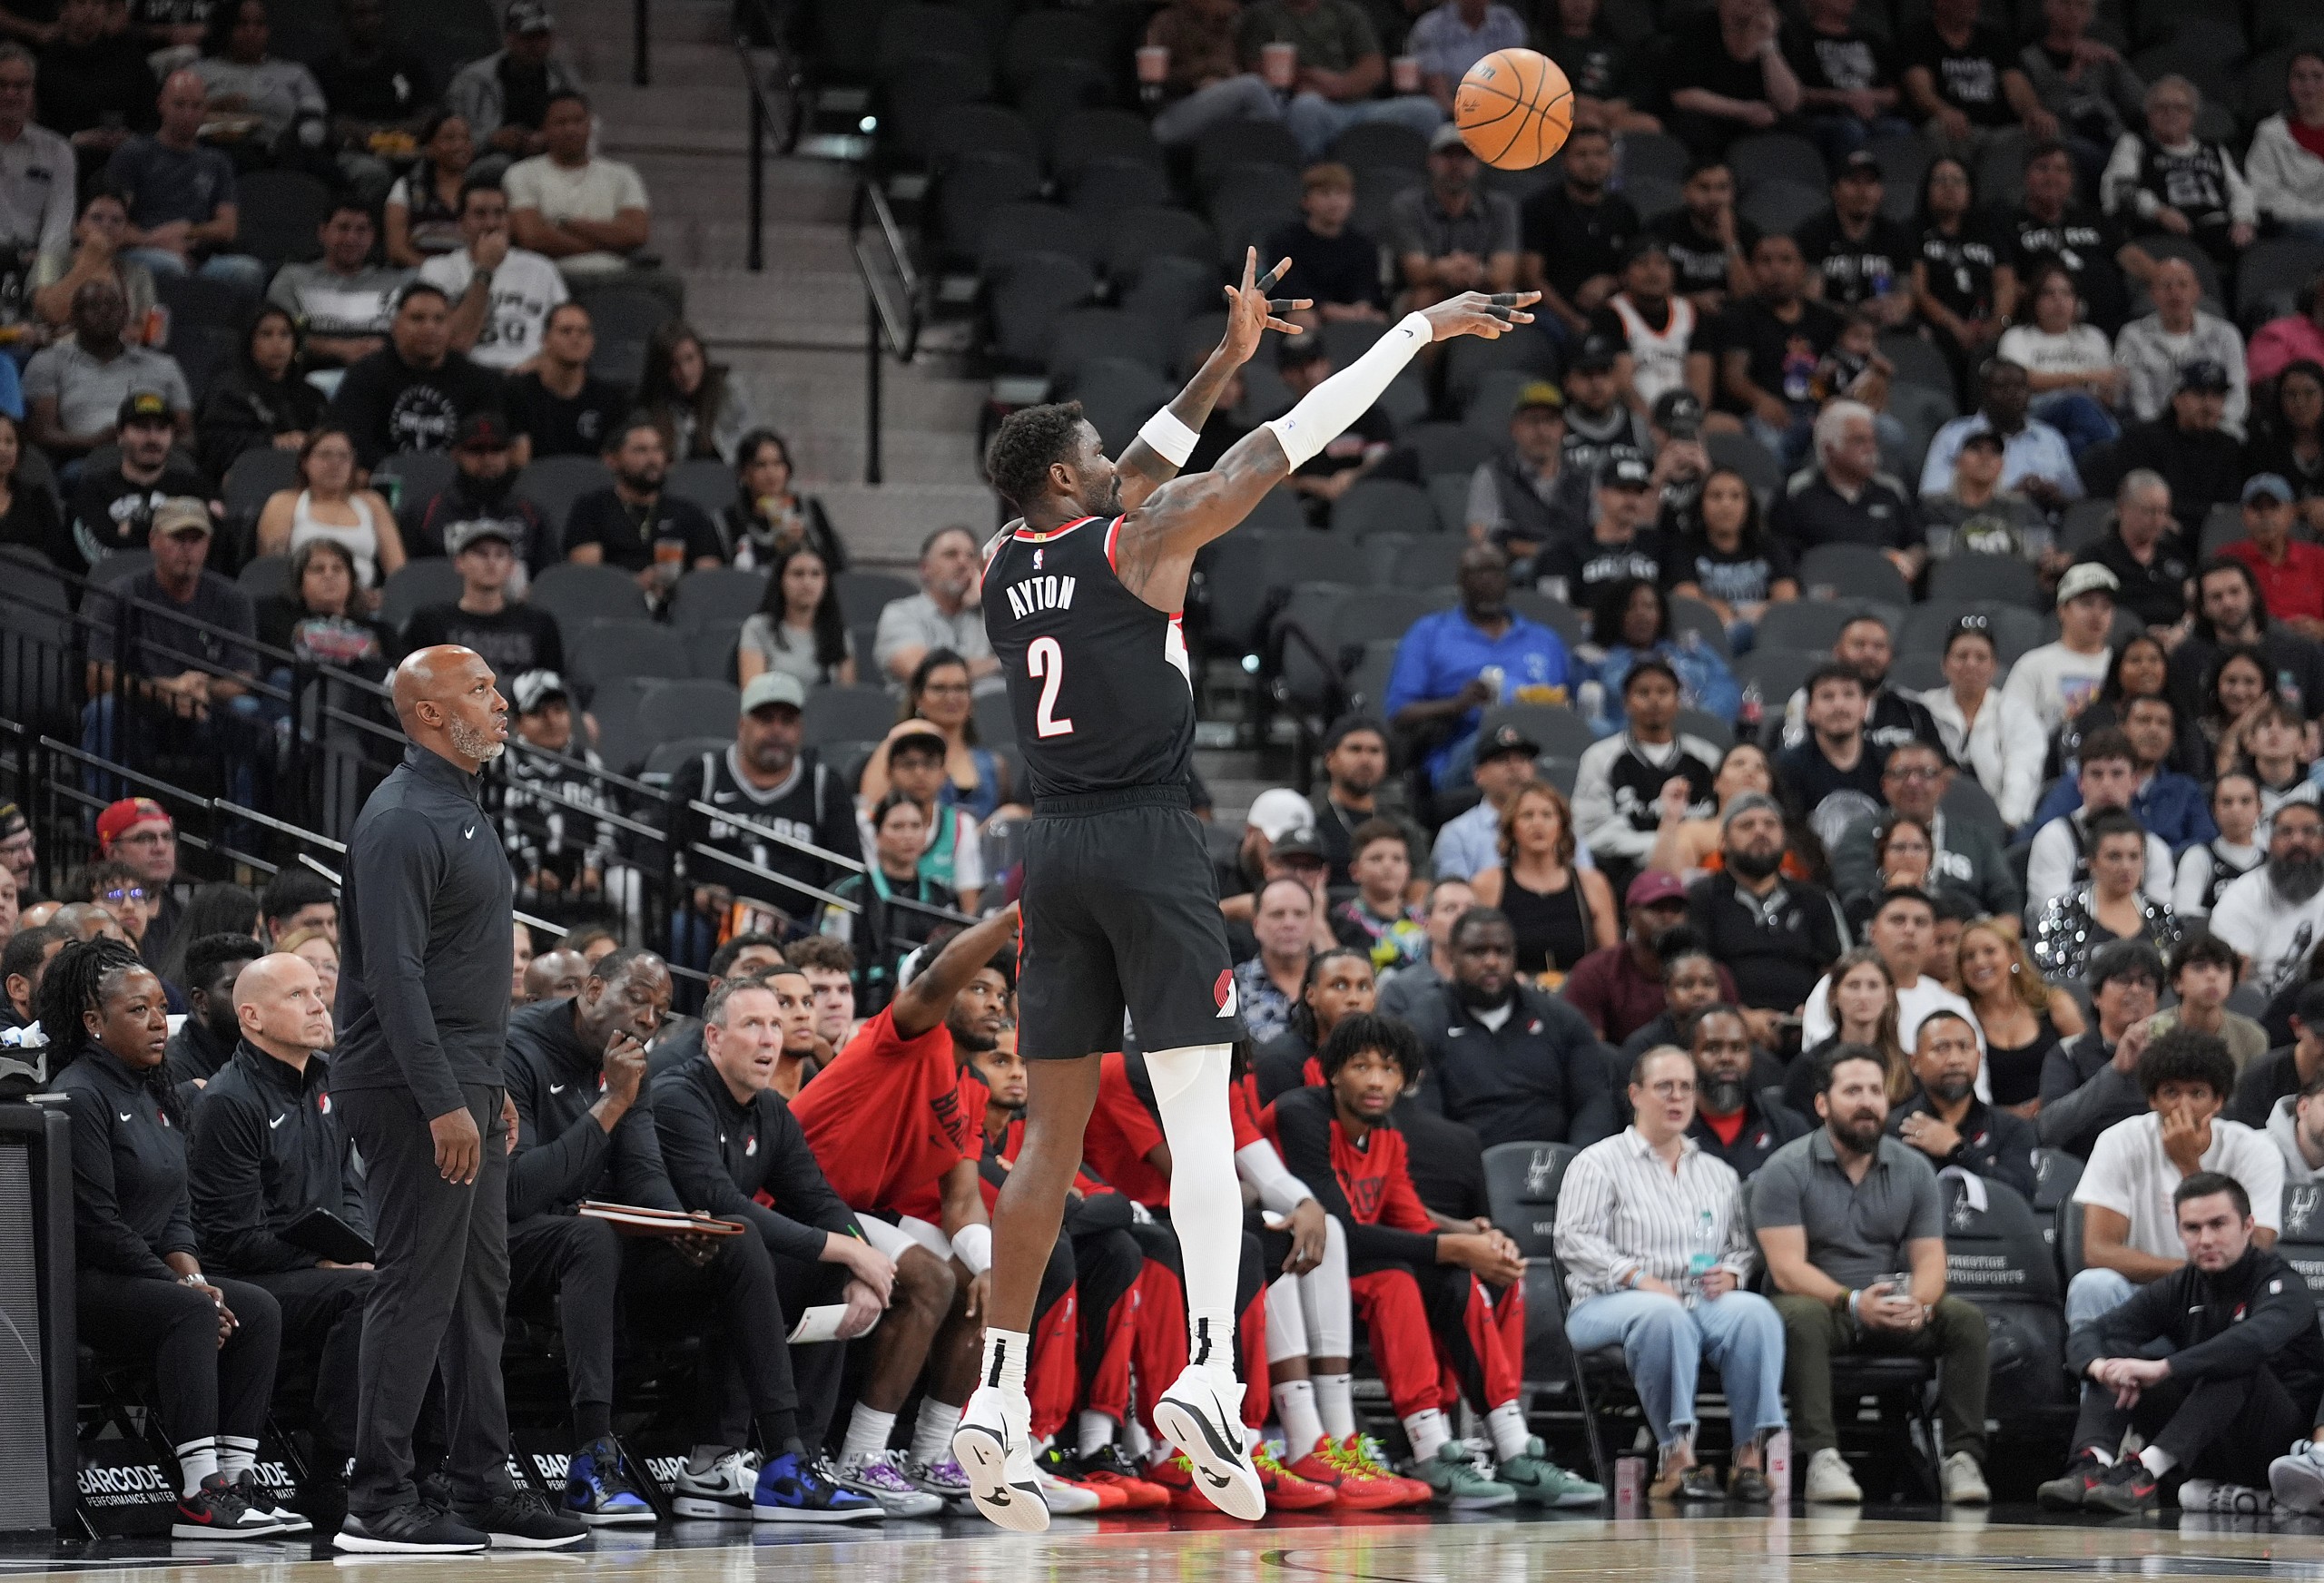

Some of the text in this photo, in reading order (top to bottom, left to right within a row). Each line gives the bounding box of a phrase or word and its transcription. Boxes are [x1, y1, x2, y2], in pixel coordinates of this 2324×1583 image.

[1006, 575, 1076, 621] AYTON
[1027, 635, 1074, 739] 2
[77, 1464, 170, 1494] BARCODE
[86, 1490, 178, 1508] PERFORMANCE WATER
